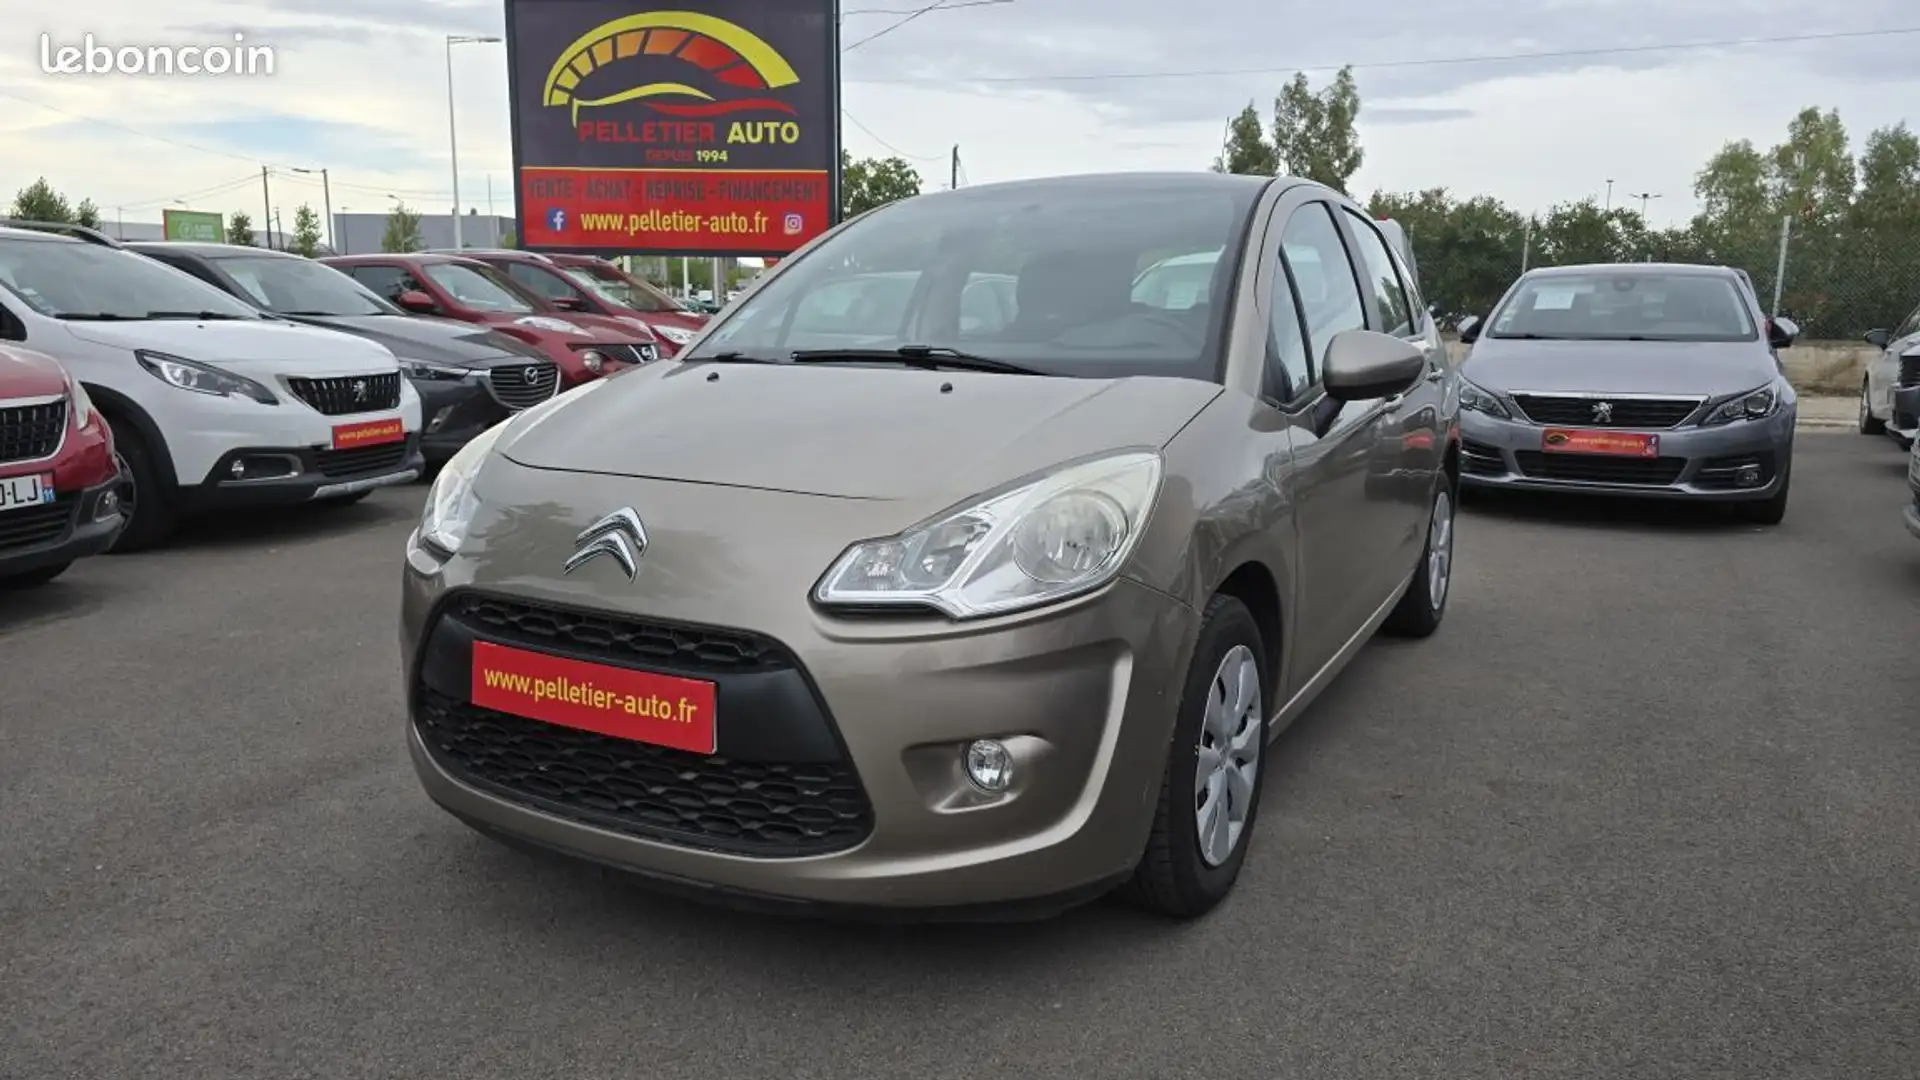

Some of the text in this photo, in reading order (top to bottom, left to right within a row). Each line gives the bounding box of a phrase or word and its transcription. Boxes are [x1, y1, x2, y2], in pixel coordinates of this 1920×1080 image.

[578, 121, 799, 144] PELLETIER AUTO
[645, 149, 728, 163] DEPUIS 1994
[529, 178, 573, 199] VENTE
[587, 179, 631, 200] ACHAT
[646, 180, 705, 201] REPRISE
[719, 181, 822, 202] FINANCEMENT
[580, 209, 769, 235] www.pelletier-auto.fr
[484, 668, 698, 723] www.pelletier-auto.fr
